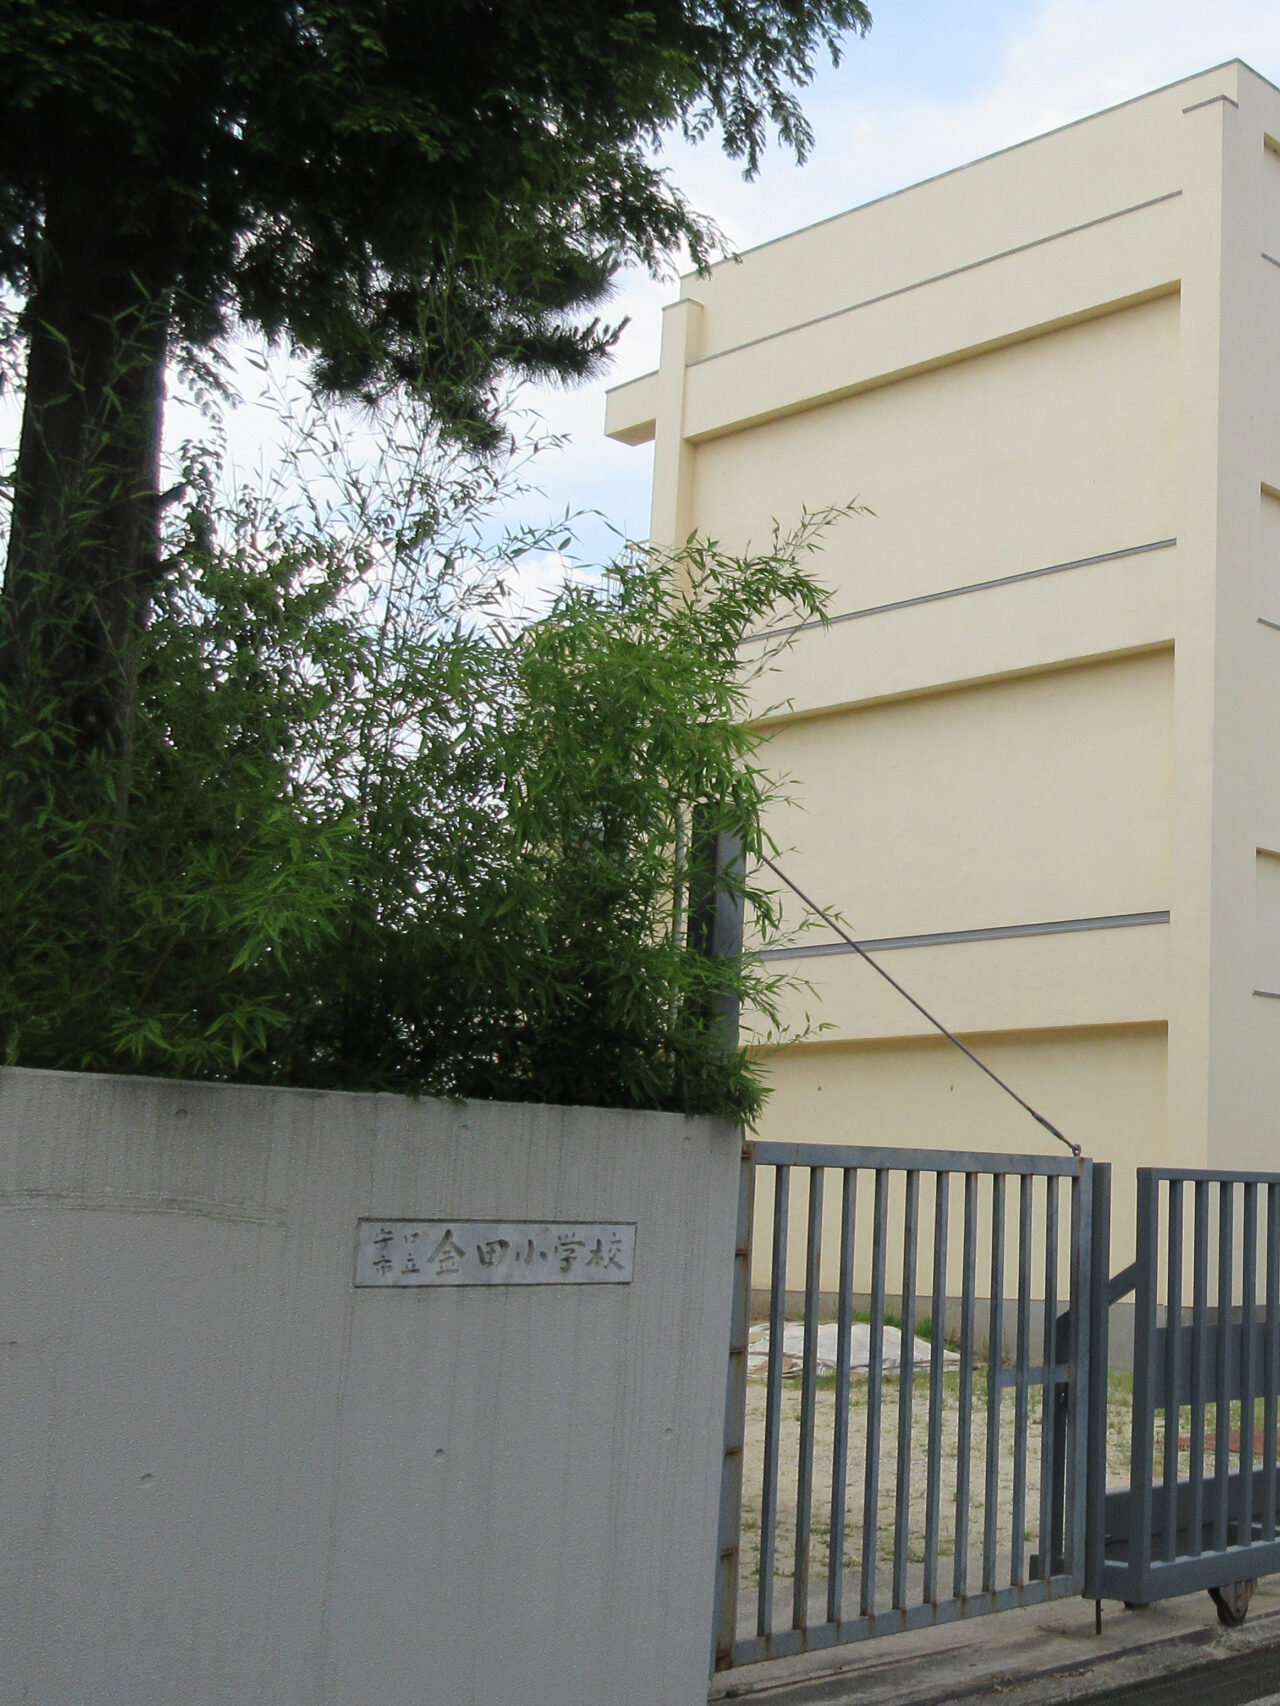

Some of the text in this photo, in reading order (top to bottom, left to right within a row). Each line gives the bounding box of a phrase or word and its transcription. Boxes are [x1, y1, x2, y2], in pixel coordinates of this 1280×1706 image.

[426, 1229, 625, 1276] 金田小学校
